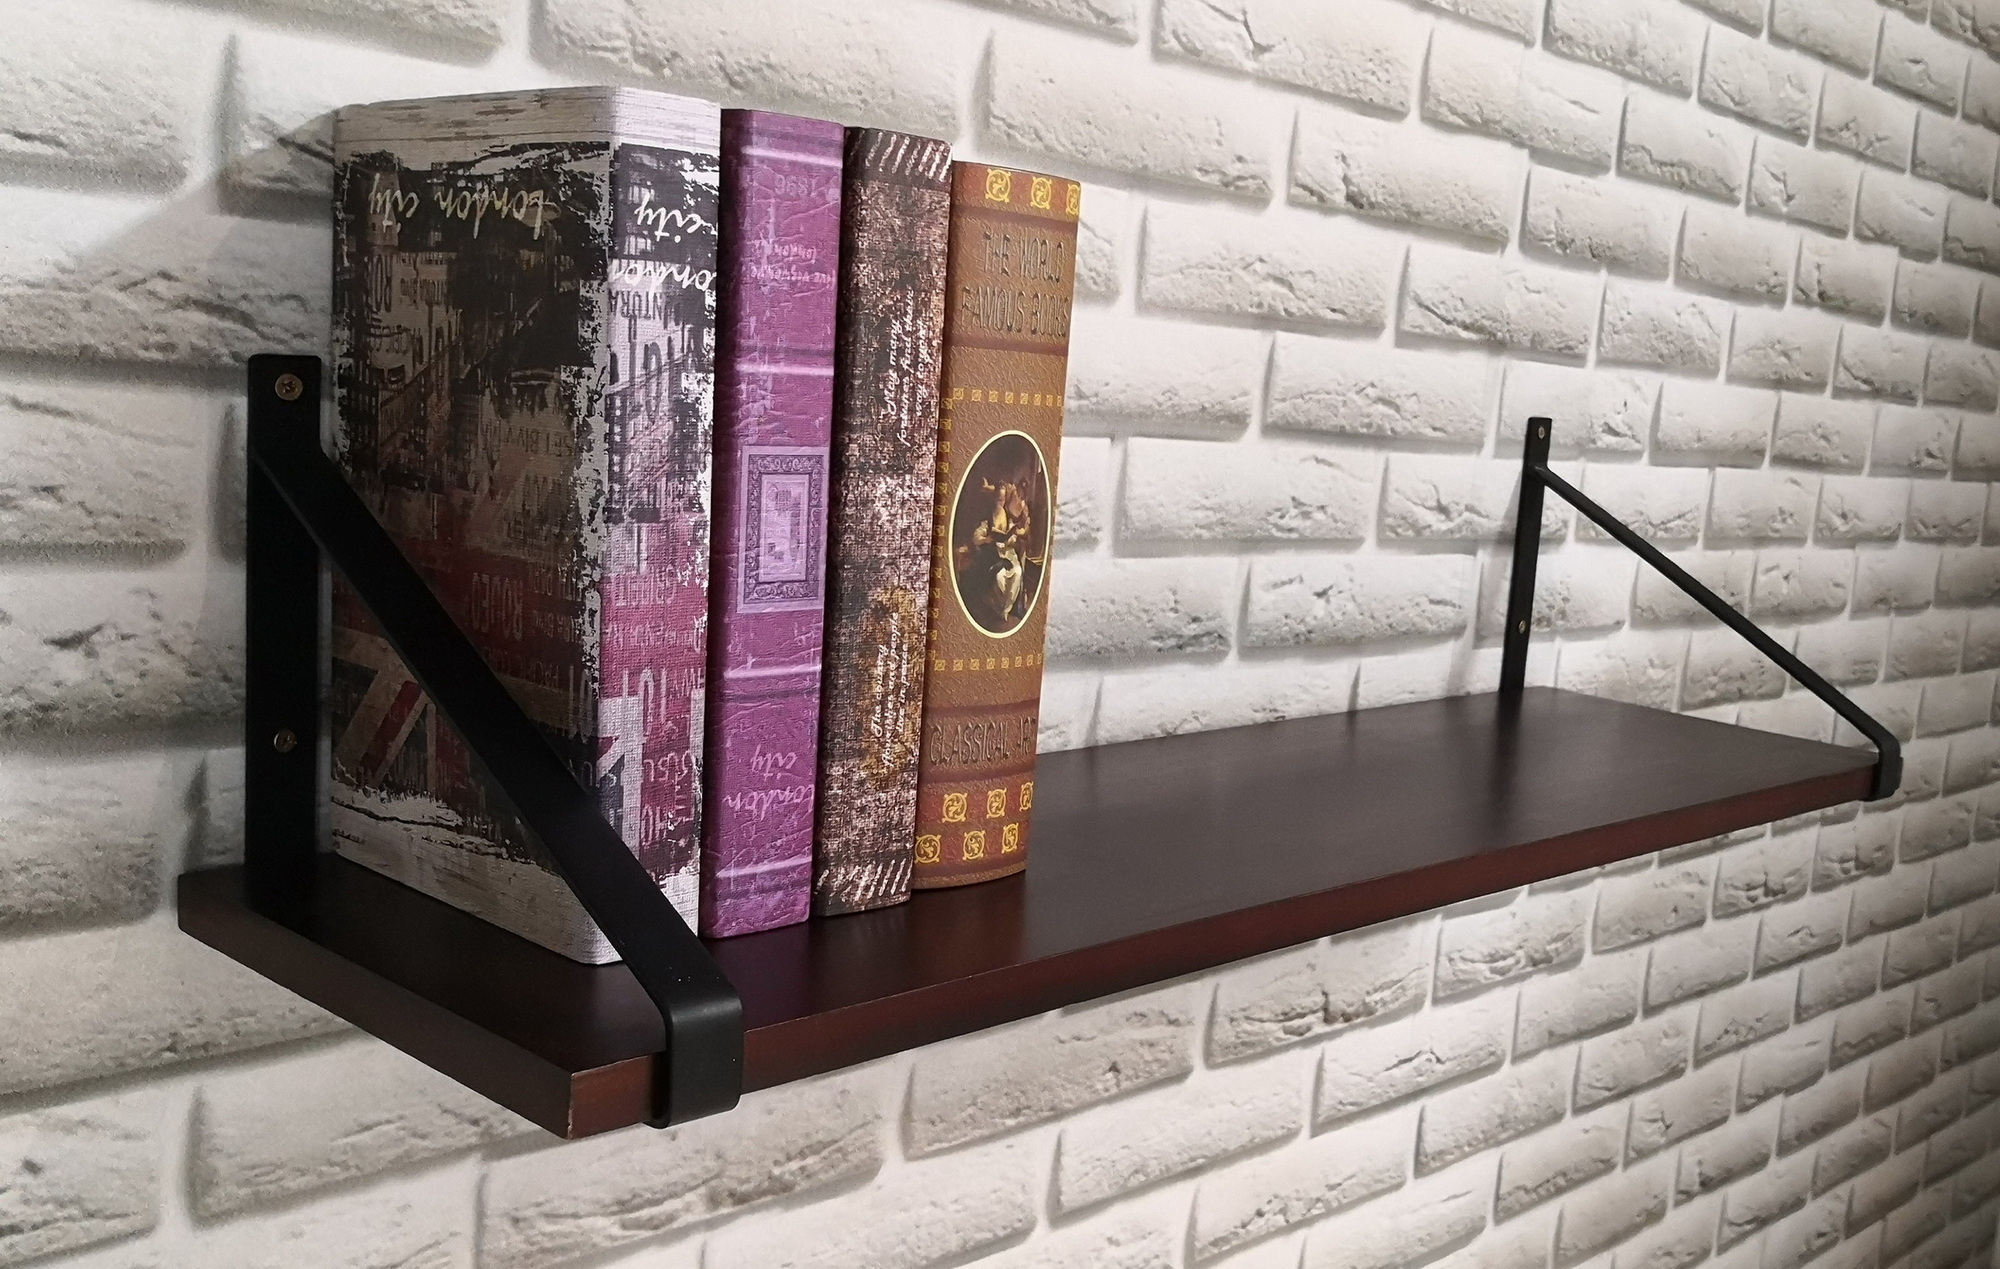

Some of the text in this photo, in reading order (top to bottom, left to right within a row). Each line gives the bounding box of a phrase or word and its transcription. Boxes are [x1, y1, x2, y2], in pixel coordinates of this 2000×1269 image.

[368, 173, 557, 239] London city
[634, 191, 708, 243] city
[983, 231, 1066, 283] THE WORLD
[961, 286, 1026, 333] FAMOUS
[883, 319, 903, 415] May many
[900, 336, 915, 374] find
[917, 362, 925, 378] to
[915, 384, 929, 417] way
[890, 611, 901, 661] people
[887, 661, 897, 690] and
[900, 642, 911, 687] peace
[871, 644, 889, 738] The country
[929, 719, 1010, 765] CLASSICAL
